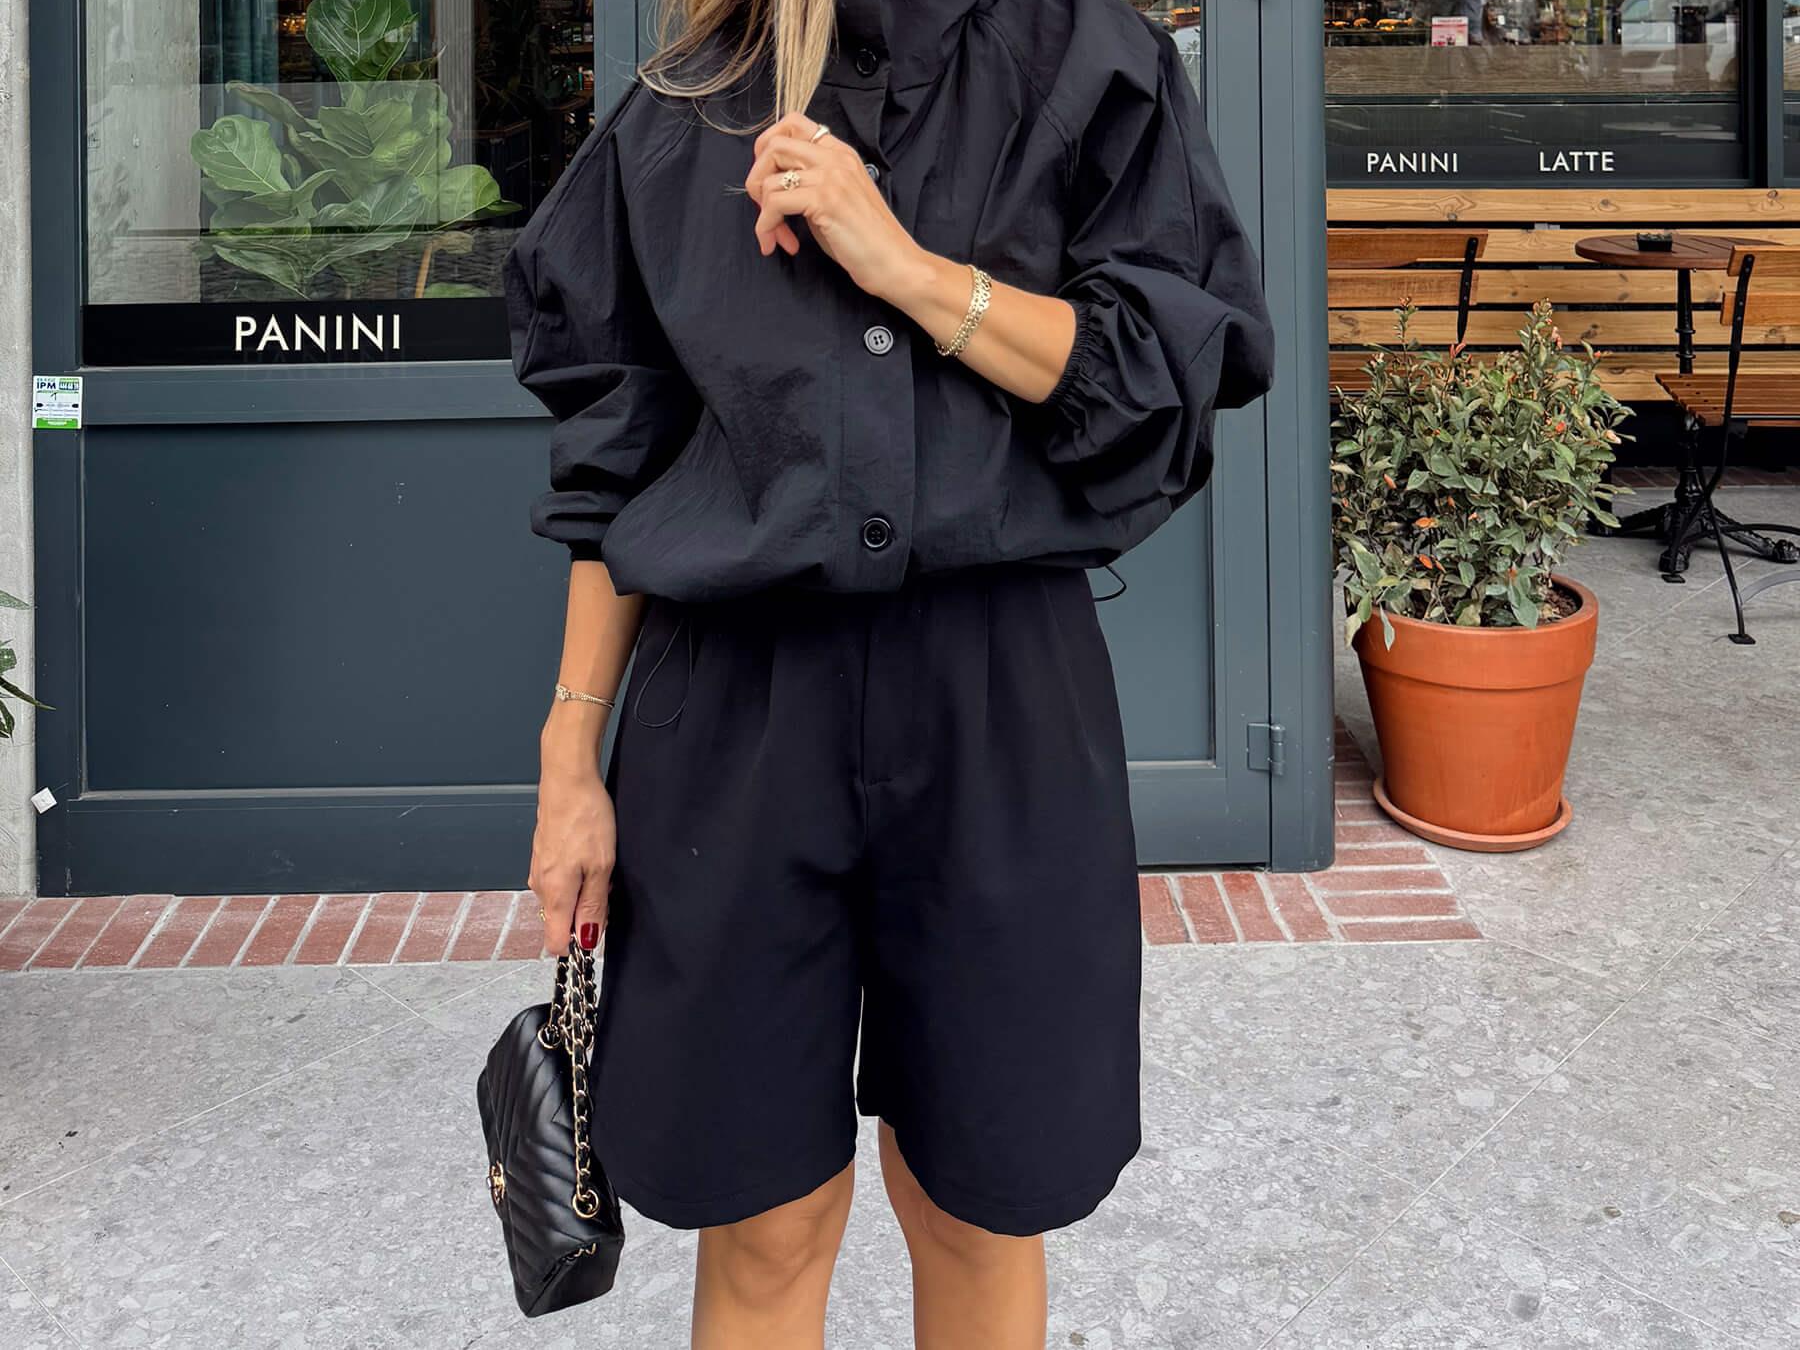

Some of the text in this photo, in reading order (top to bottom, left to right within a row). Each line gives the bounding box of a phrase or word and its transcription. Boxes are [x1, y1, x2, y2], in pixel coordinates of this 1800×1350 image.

[1367, 152, 1458, 173] PANINI
[1539, 151, 1615, 172] LATTE
[235, 313, 400, 352] PANINI
